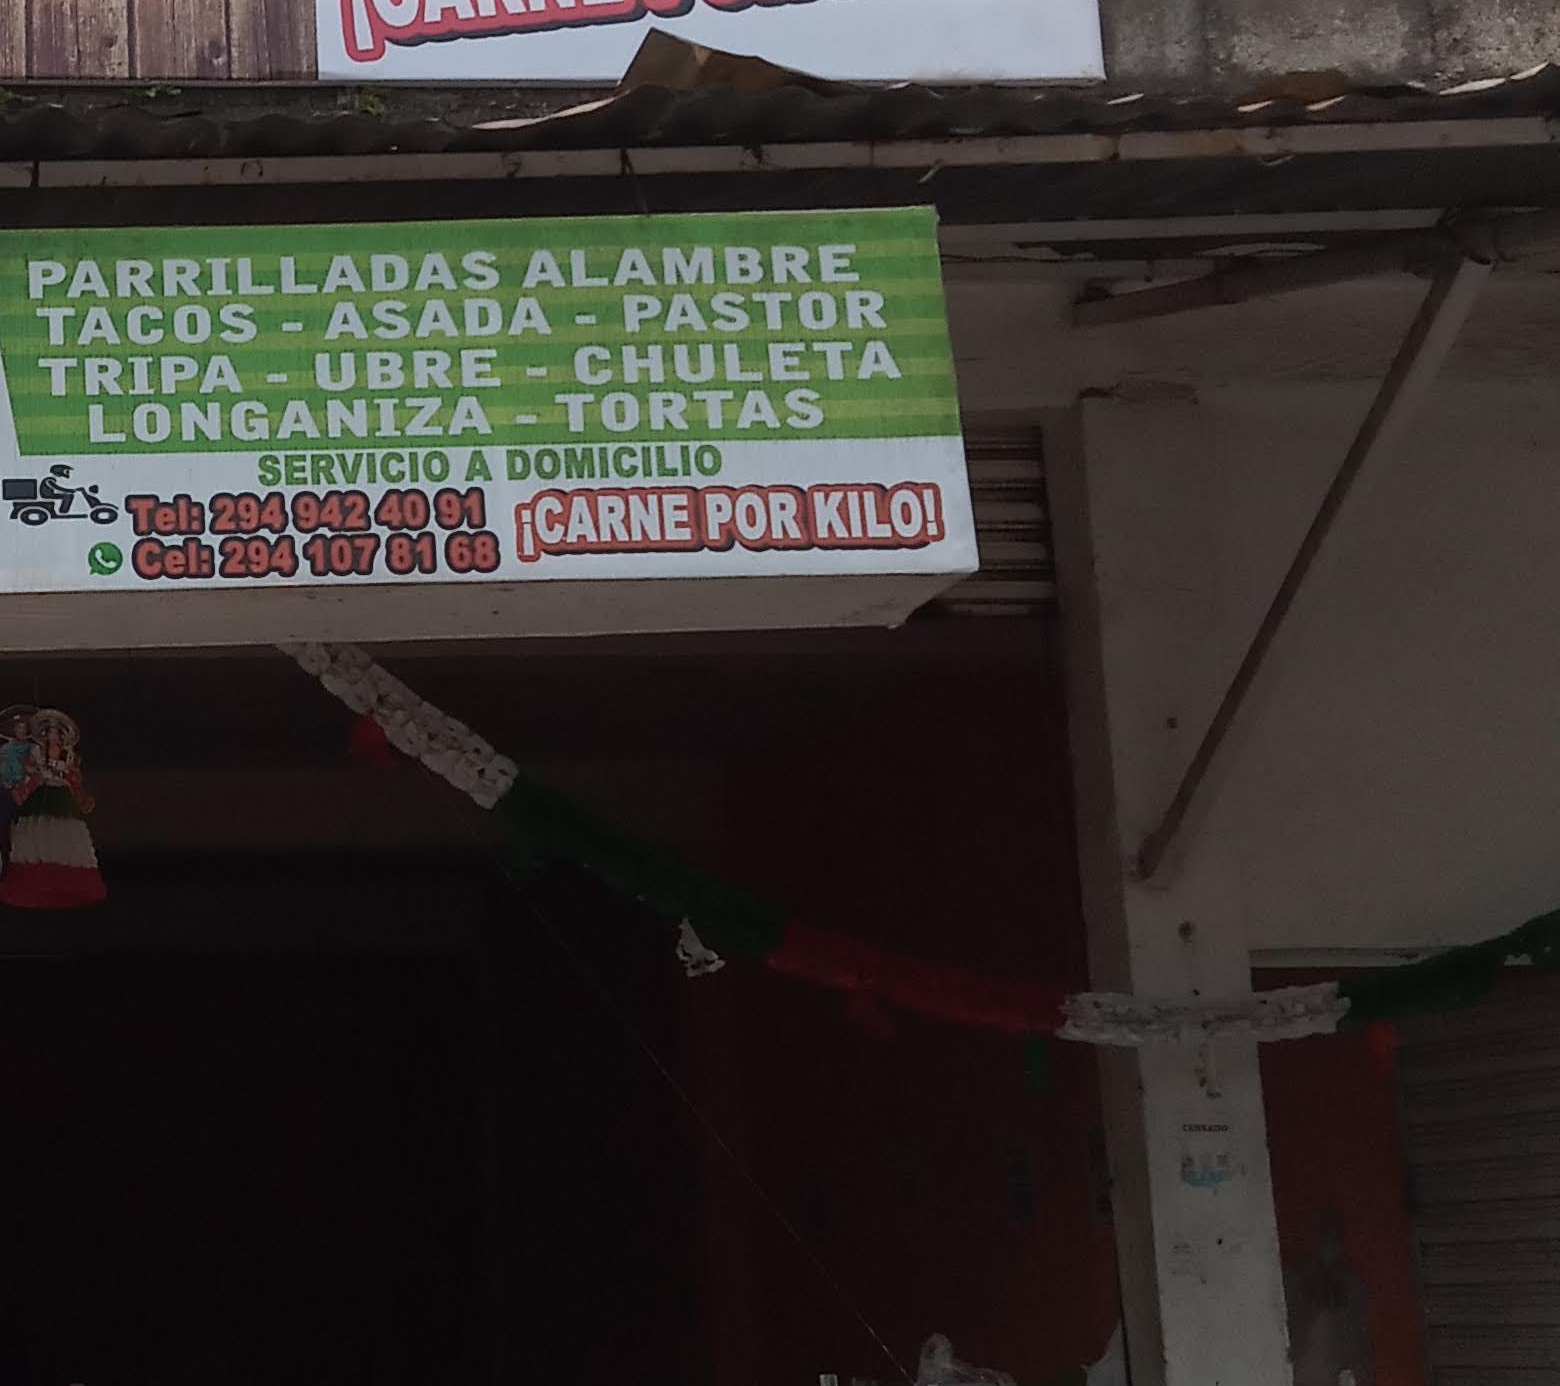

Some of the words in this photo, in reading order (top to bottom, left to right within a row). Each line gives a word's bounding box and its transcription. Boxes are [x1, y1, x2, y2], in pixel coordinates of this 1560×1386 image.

[27, 248, 499, 299] PARRILLADAS
[522, 244, 859, 289] ALAMBRE
[36, 303, 258, 346] TACOS
[323, 298, 551, 340] ASADA
[624, 291, 887, 333] PASTOR
[39, 355, 241, 397] TRIPA
[314, 349, 501, 392] UBRE
[573, 340, 902, 386] CHULETA
[88, 397, 492, 443] LONGANIZA
[555, 389, 824, 433] TORTAS
[257, 450, 448, 486] SERVICIO
[464, 451, 493, 481] A
[506, 446, 722, 482] DOMICILIO
[127, 495, 202, 534] Tel:
[210, 493, 284, 533] 294
[295, 490, 370, 531] 942
[376, 490, 429, 528] 40
[434, 489, 486, 528] 91
[519, 494, 692, 559] ¡CARNE
[706, 493, 805, 542] POR
[811, 488, 936, 539] KILO!
[133, 541, 213, 579] Cel:
[220, 537, 299, 578] 294
[302, 537, 378, 576] 107
[386, 535, 436, 575] 81
[444, 533, 499, 573] 68
